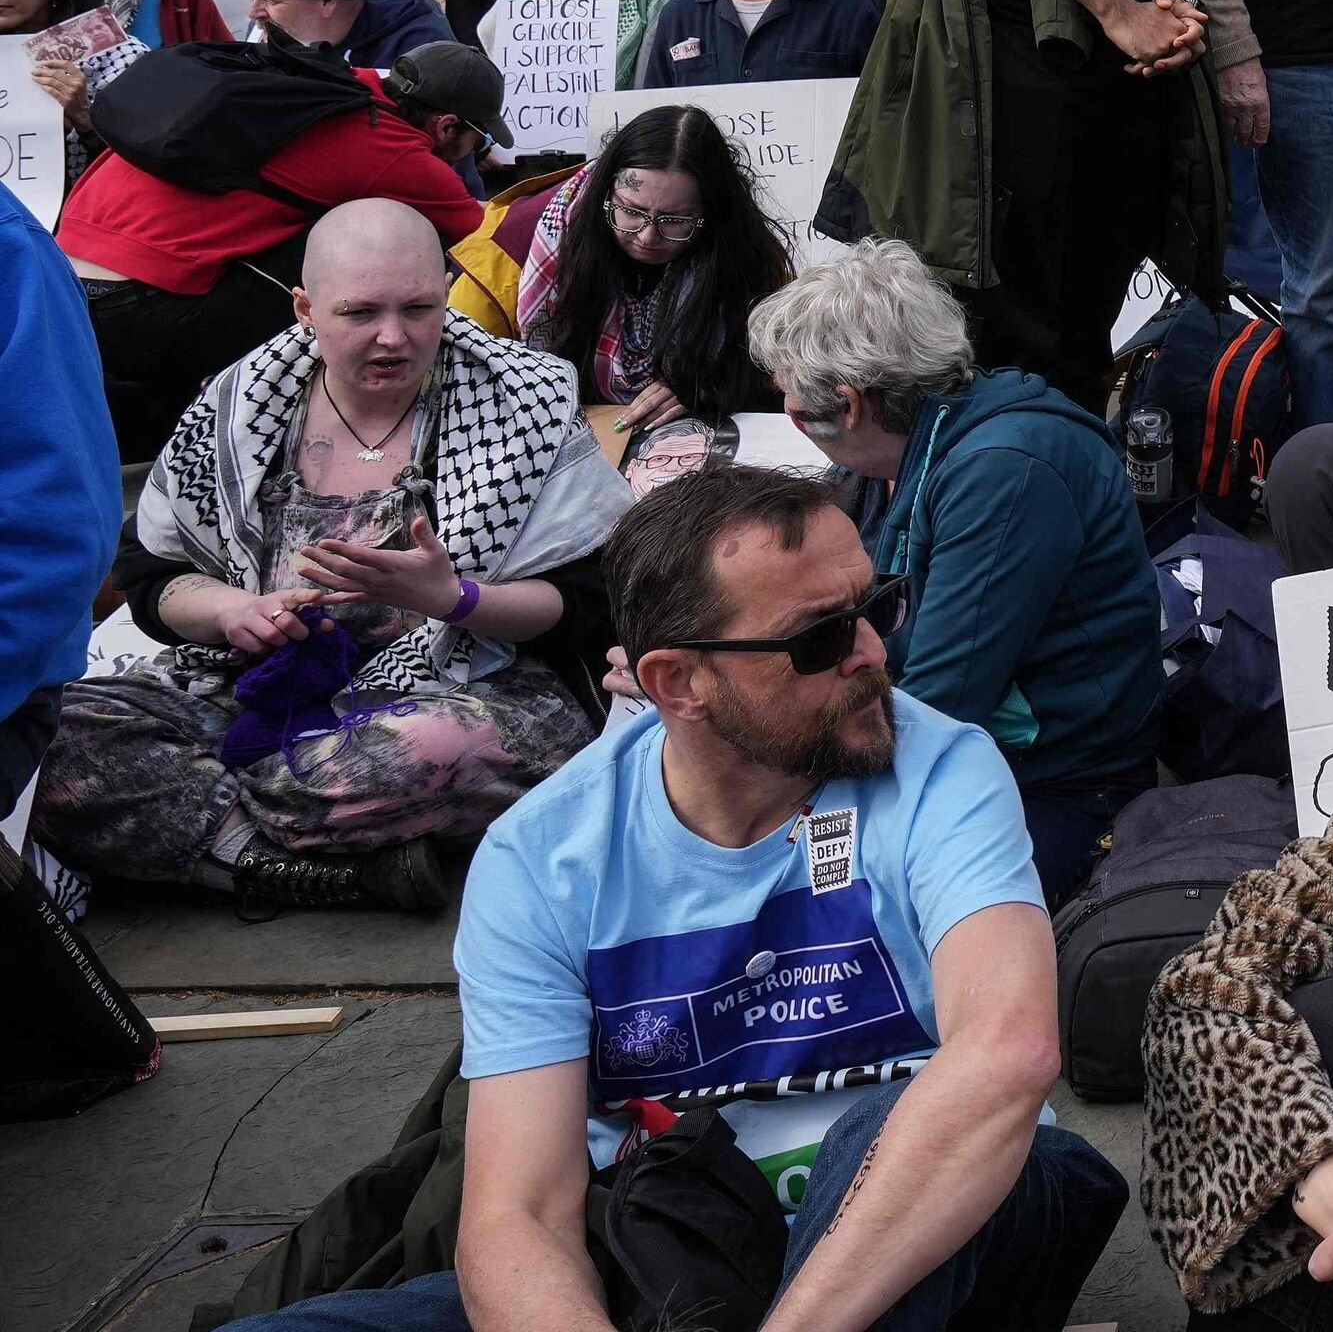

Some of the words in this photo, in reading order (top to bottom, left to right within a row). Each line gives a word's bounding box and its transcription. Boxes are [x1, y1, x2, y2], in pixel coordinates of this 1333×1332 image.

[508, 0, 514, 19] I
[512, 21, 603, 42] GENOCIDE
[501, 47, 508, 68] I
[517, 44, 604, 67] SUPPORT
[503, 69, 607, 95] PALESTINE
[501, 105, 588, 131] ACTION
[814, 818, 847, 837] RESIST
[817, 841, 846, 860] DEFY
[816, 870, 846, 885] COMPLY
[817, 865, 829, 875] DO
[830, 861, 846, 872] NOT
[712, 959, 863, 1016] METROPOLITAN
[744, 993, 849, 1027] POLICE
